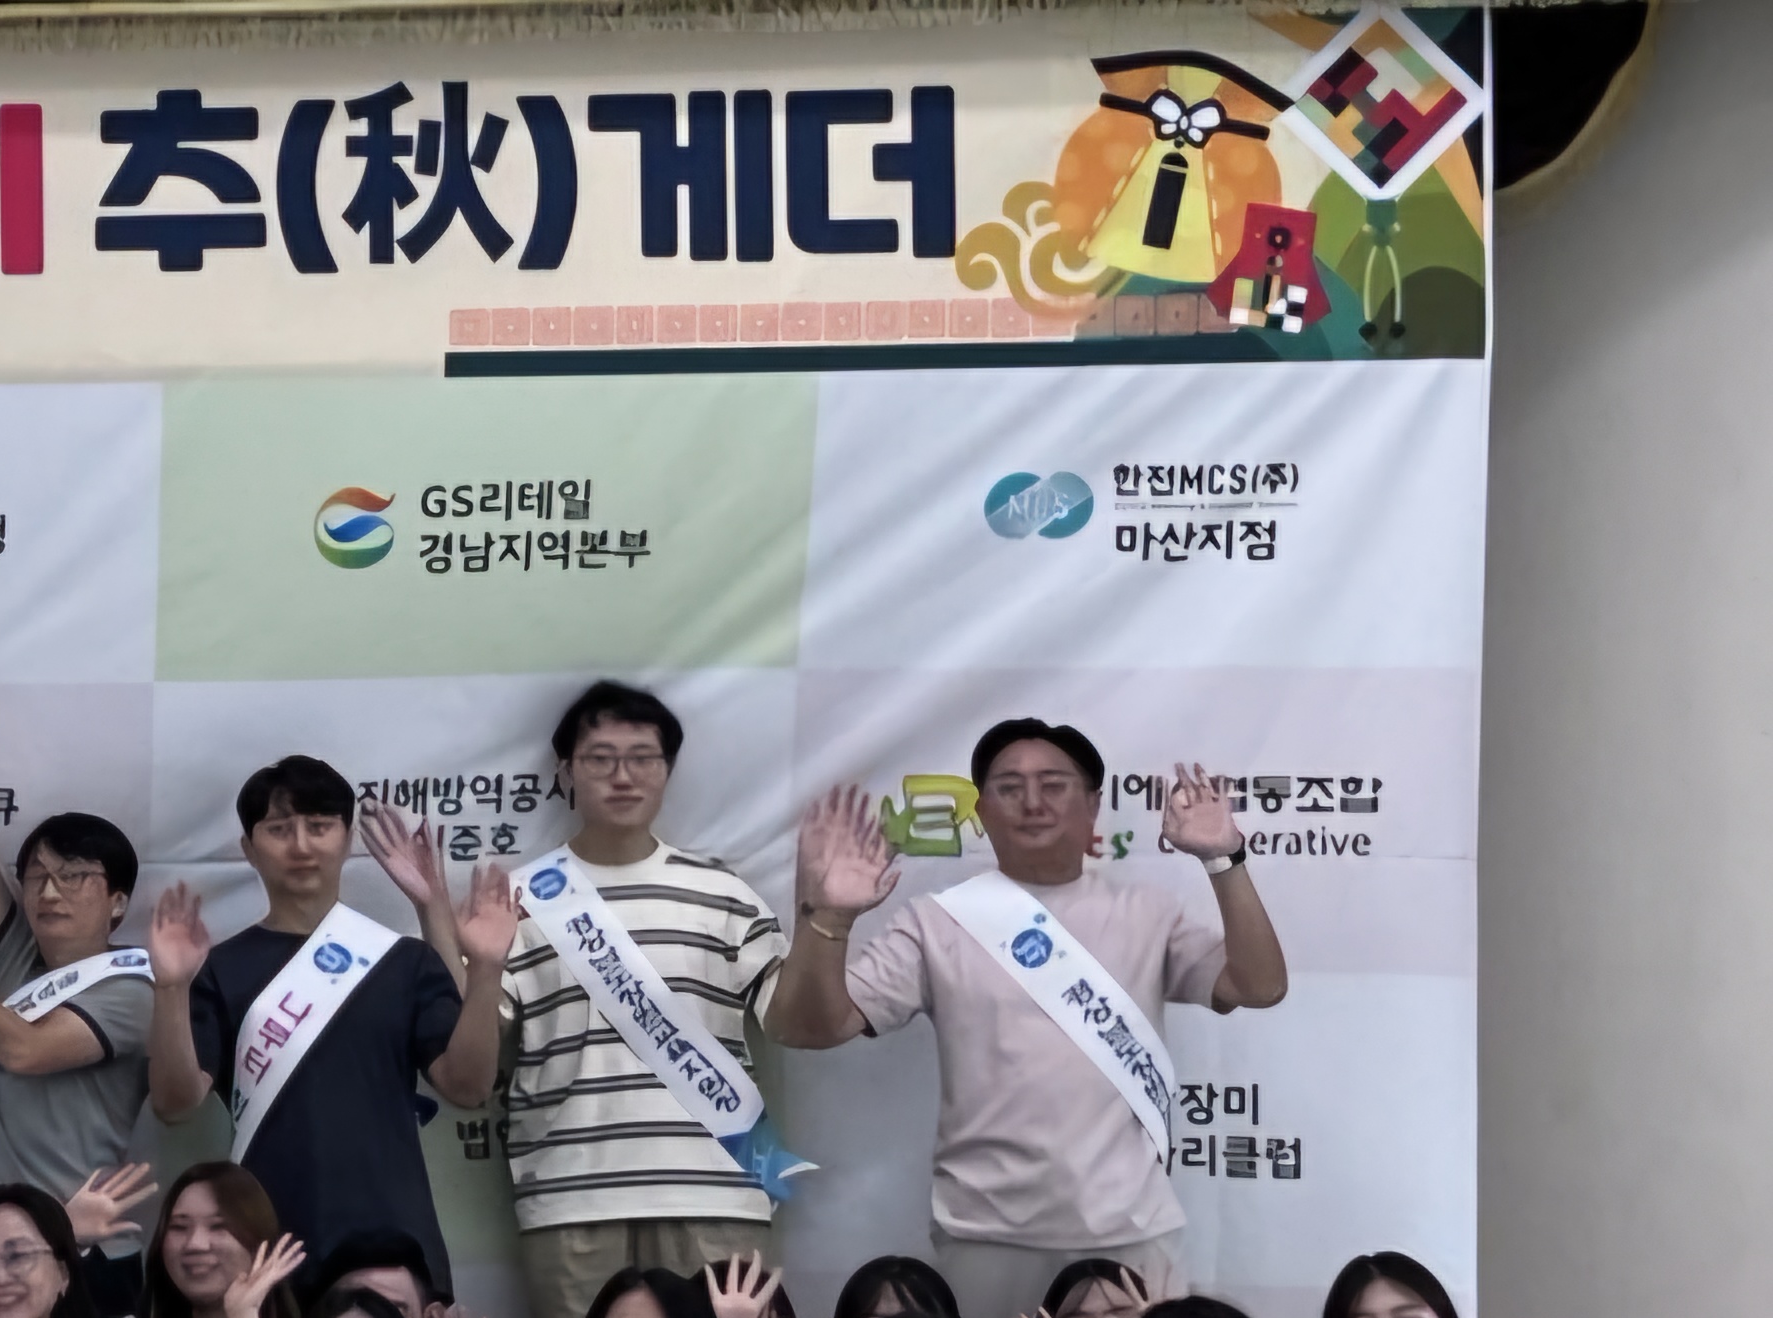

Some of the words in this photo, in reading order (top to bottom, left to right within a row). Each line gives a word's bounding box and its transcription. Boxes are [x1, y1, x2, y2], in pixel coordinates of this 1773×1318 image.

[94, 80, 957, 275] 추(秋)게더
[420, 478, 592, 522] GS리테일
[419, 529, 651, 575] 경남지역본부
[1115, 519, 1277, 563] 마산지점
